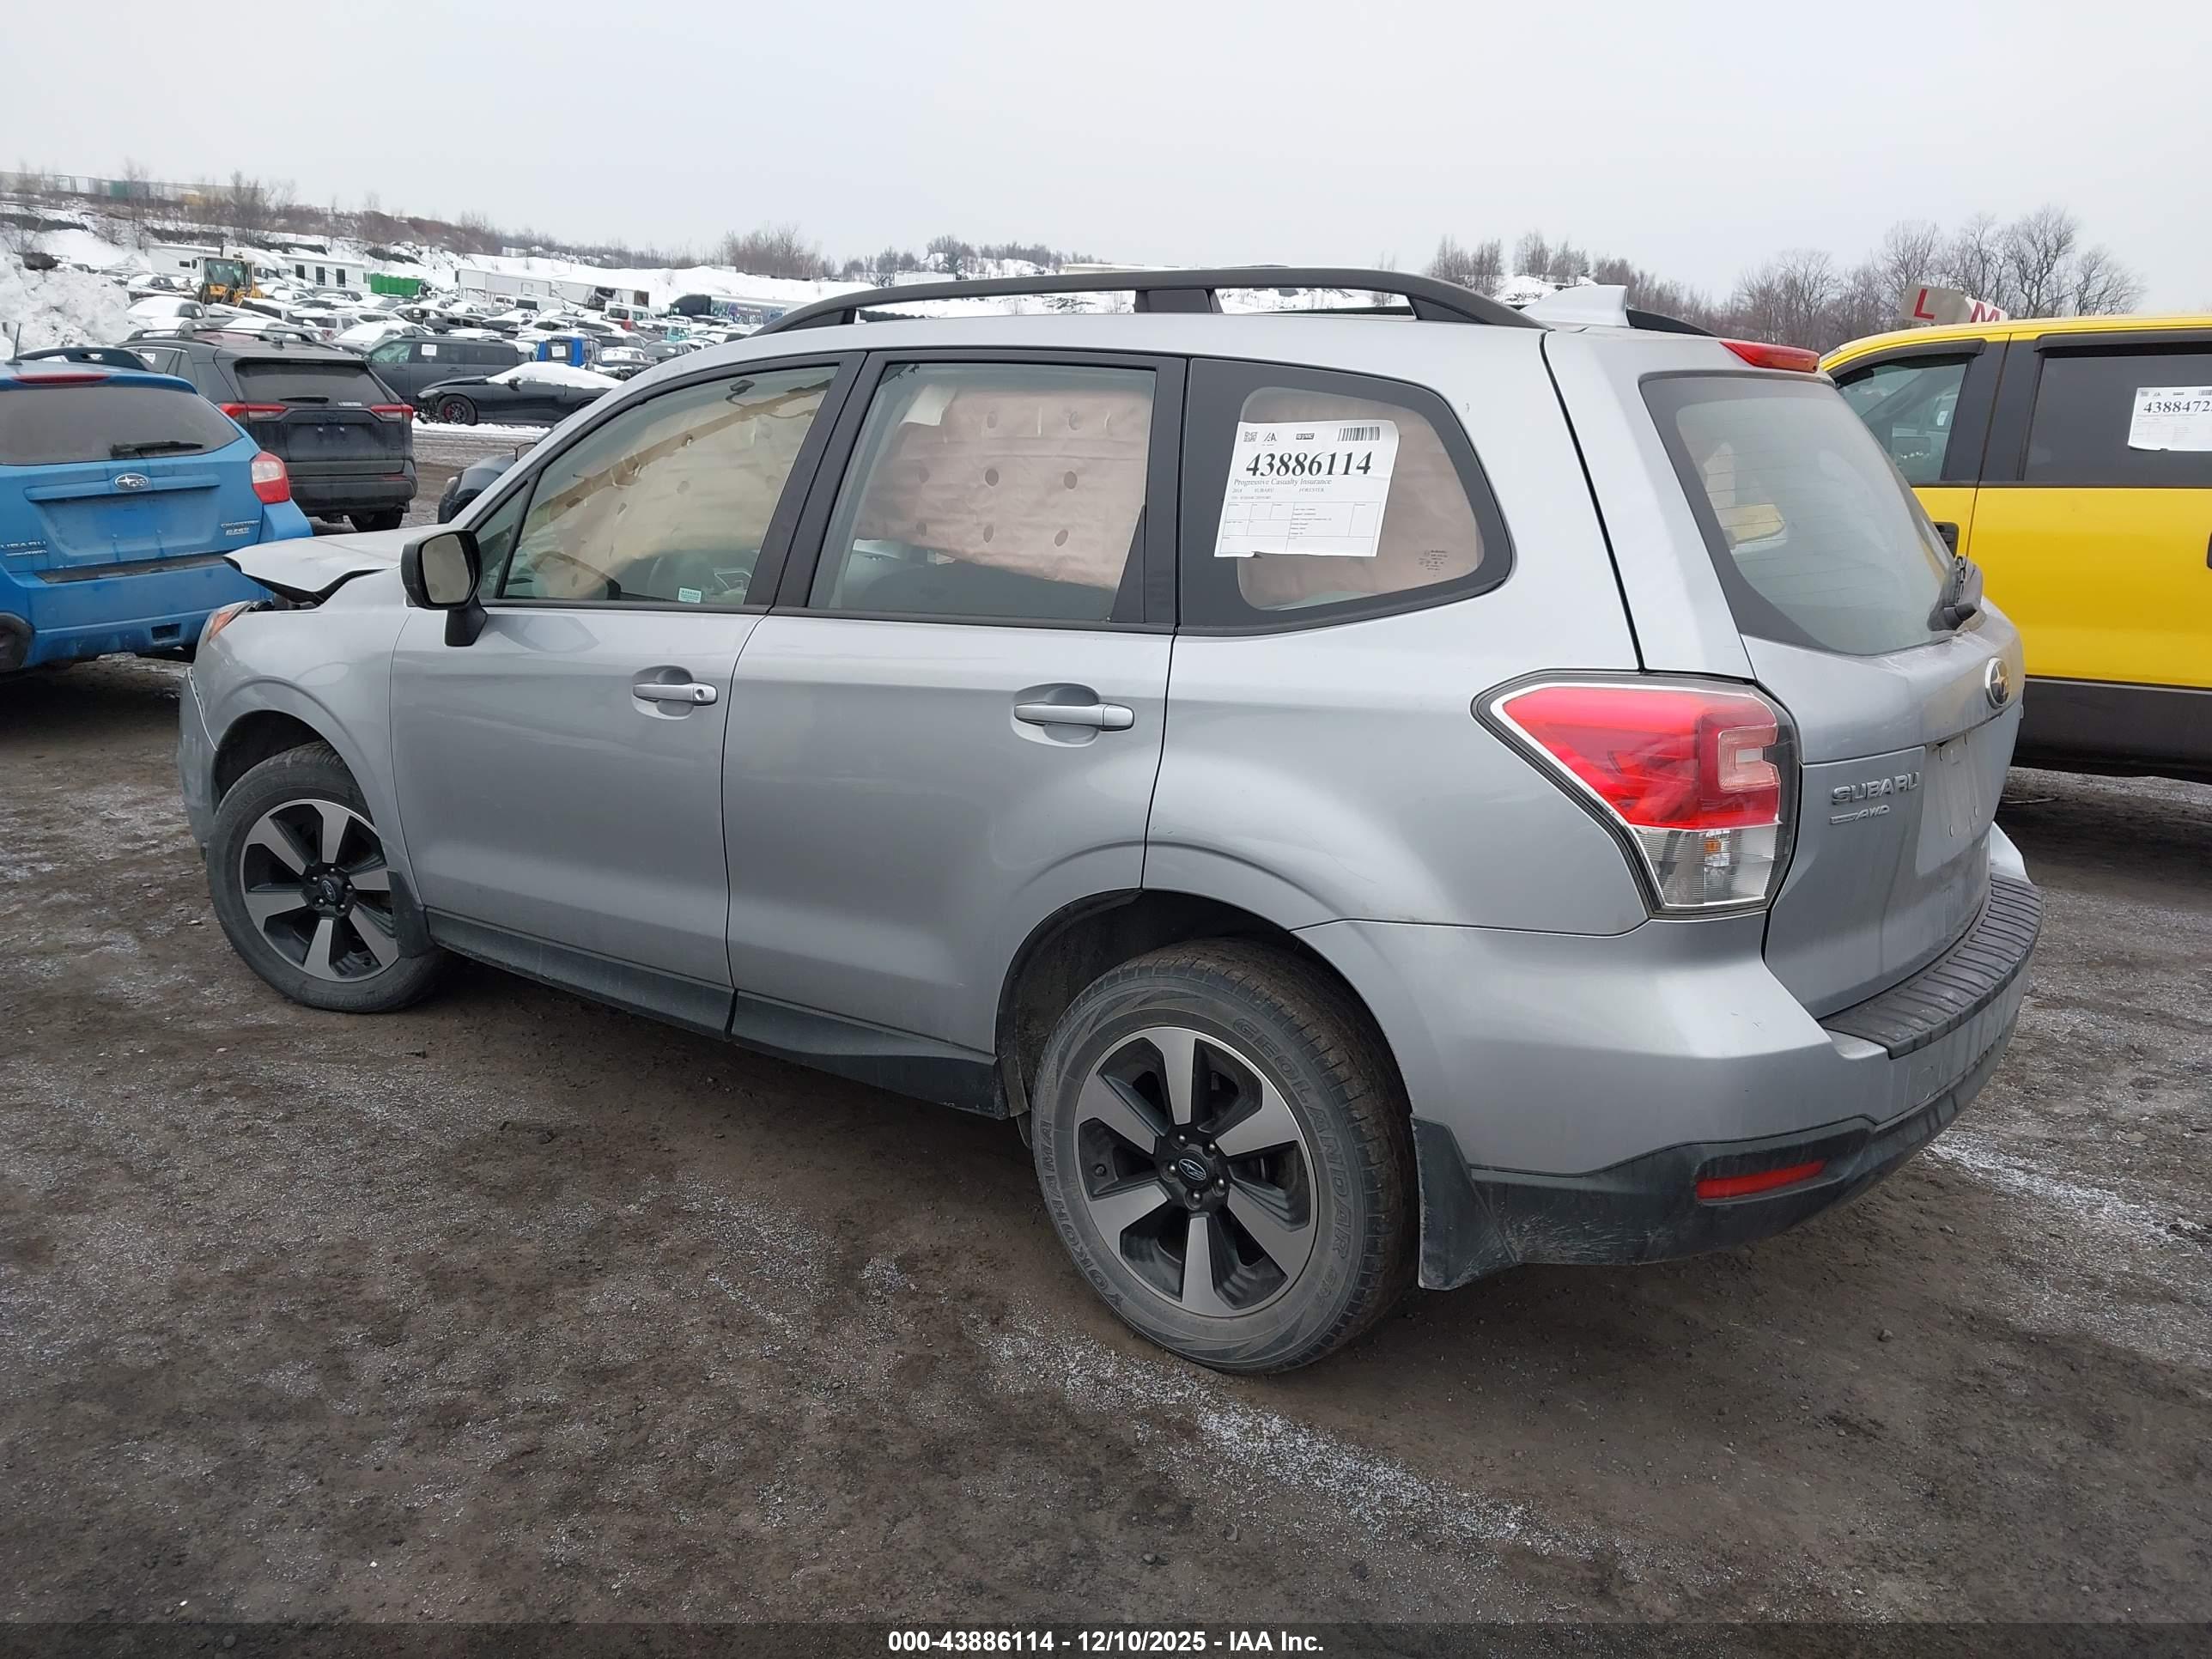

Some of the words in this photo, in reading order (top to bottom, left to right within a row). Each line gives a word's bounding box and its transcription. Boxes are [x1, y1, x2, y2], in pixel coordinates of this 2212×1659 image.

[2142, 400, 2212, 414] 4388472
[1245, 451, 1373, 477] 43886114
[1233, 478, 1270, 488] Progressive
[1271, 477, 1298, 487] Casualty
[1300, 477, 1333, 486] Insurance
[0, 540, 47, 550] UBARU
[1832, 771, 1920, 805] SUBARU
[1232, 1017, 1353, 1261] GEOLANDAR
[1039, 1119, 1125, 1311] YOKOHAMA
